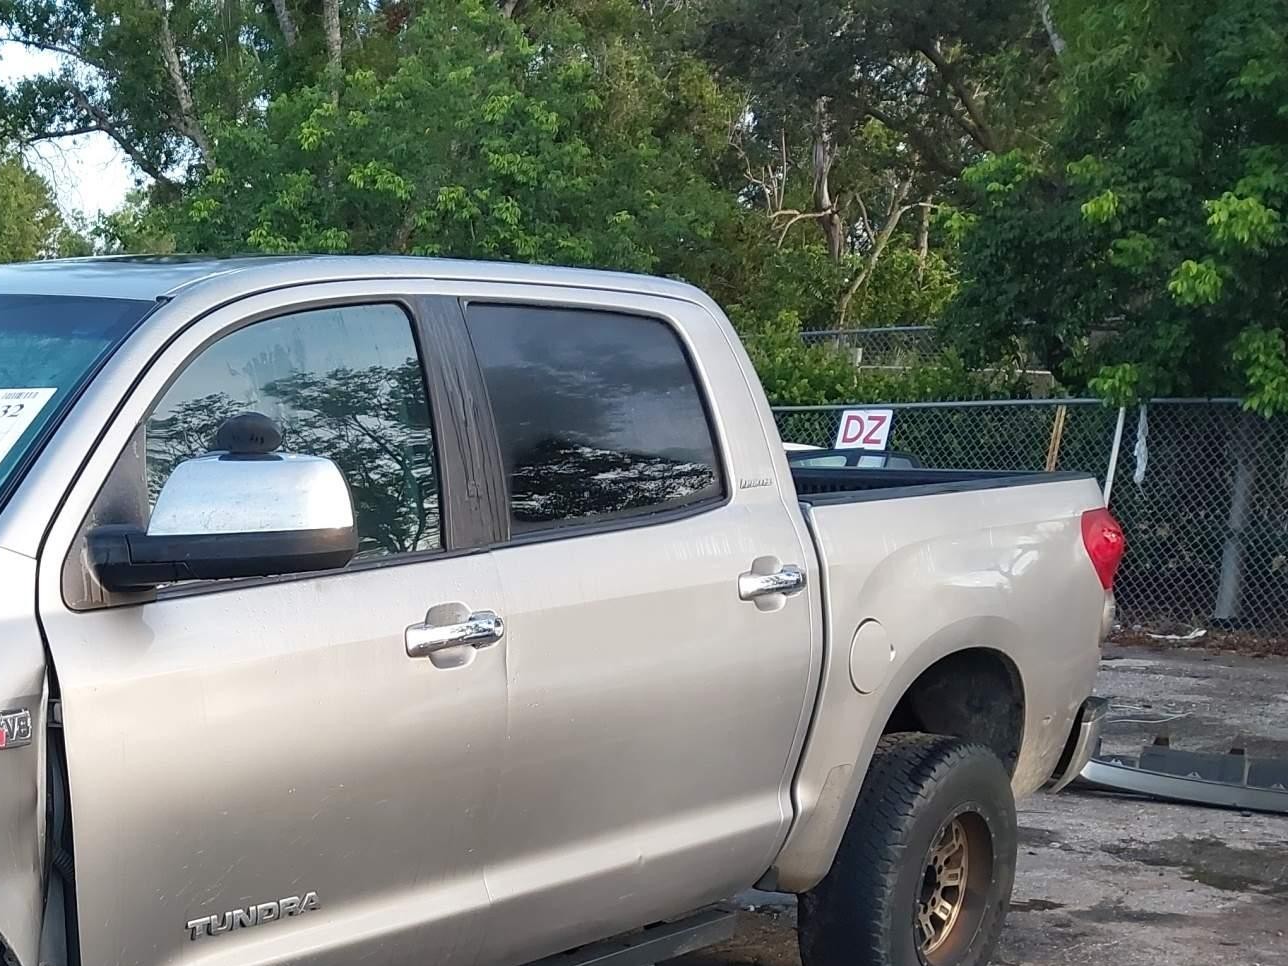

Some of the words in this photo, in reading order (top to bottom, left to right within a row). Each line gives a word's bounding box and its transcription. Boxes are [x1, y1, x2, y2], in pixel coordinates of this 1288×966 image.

[841, 415, 887, 444] DZ
[3, 713, 31, 740] V8
[186, 891, 321, 940] TUNDRA
